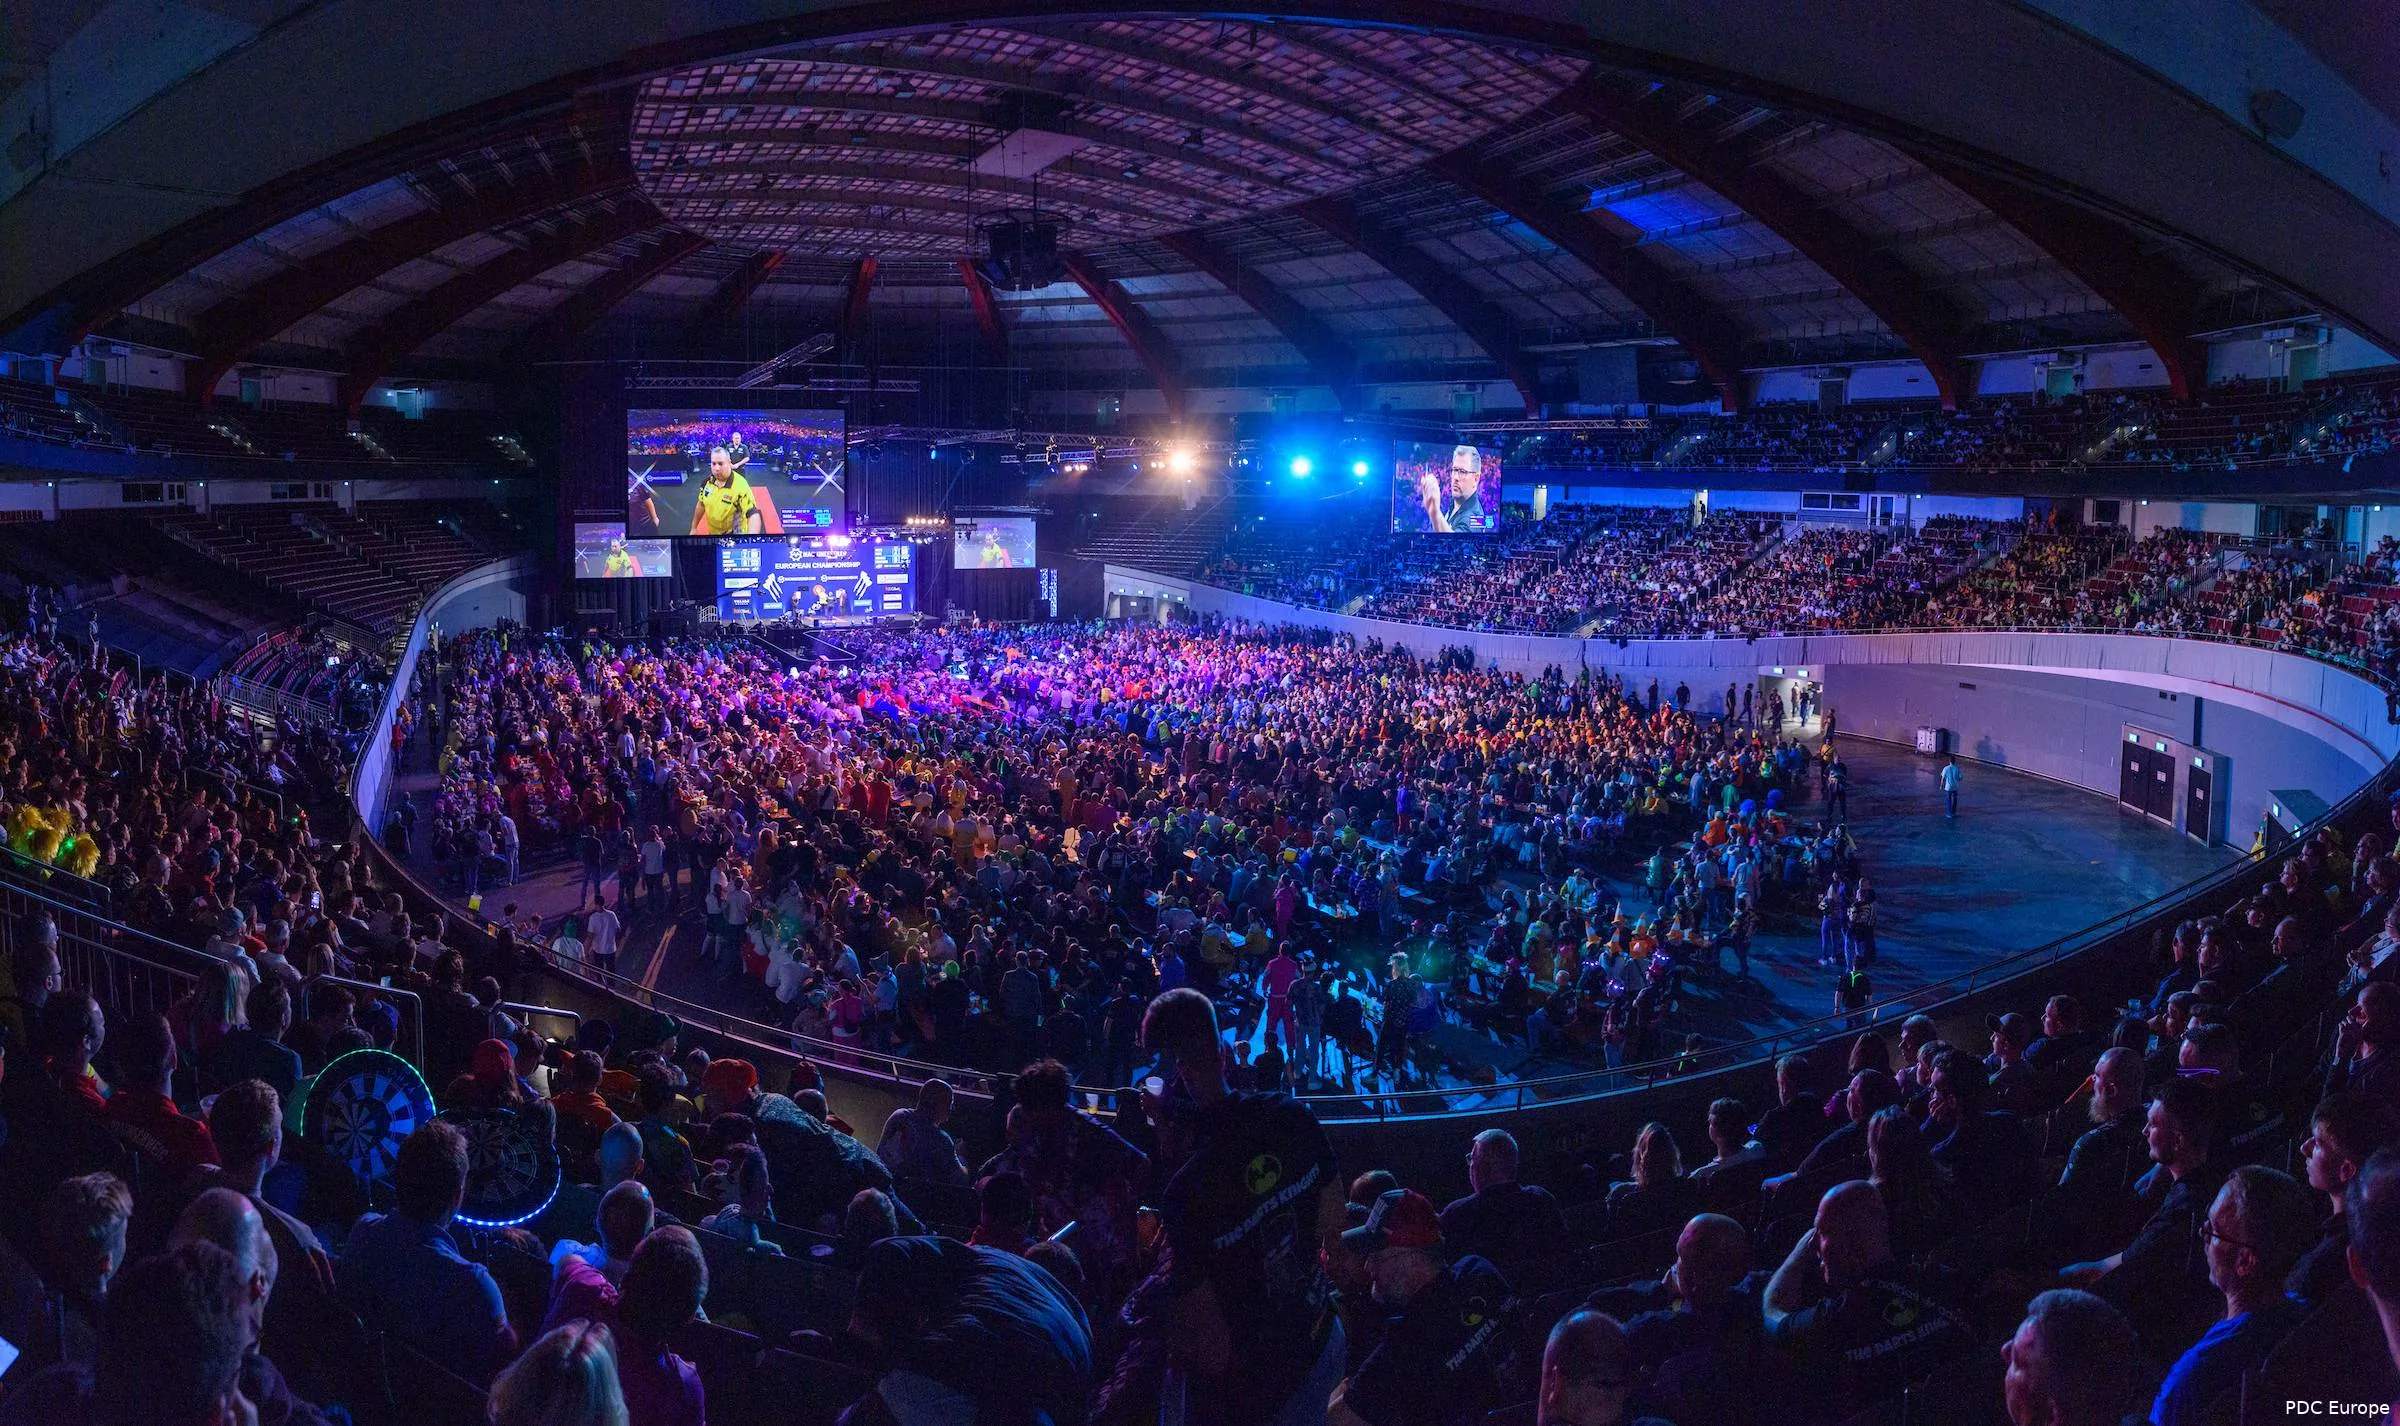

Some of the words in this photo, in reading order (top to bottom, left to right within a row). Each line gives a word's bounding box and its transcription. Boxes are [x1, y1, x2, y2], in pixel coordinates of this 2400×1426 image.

[812, 561, 861, 569] CHAMPIONSHIP
[1464, 1322, 1492, 1354] DARTS
[1873, 1329, 1917, 1356] DARTS
